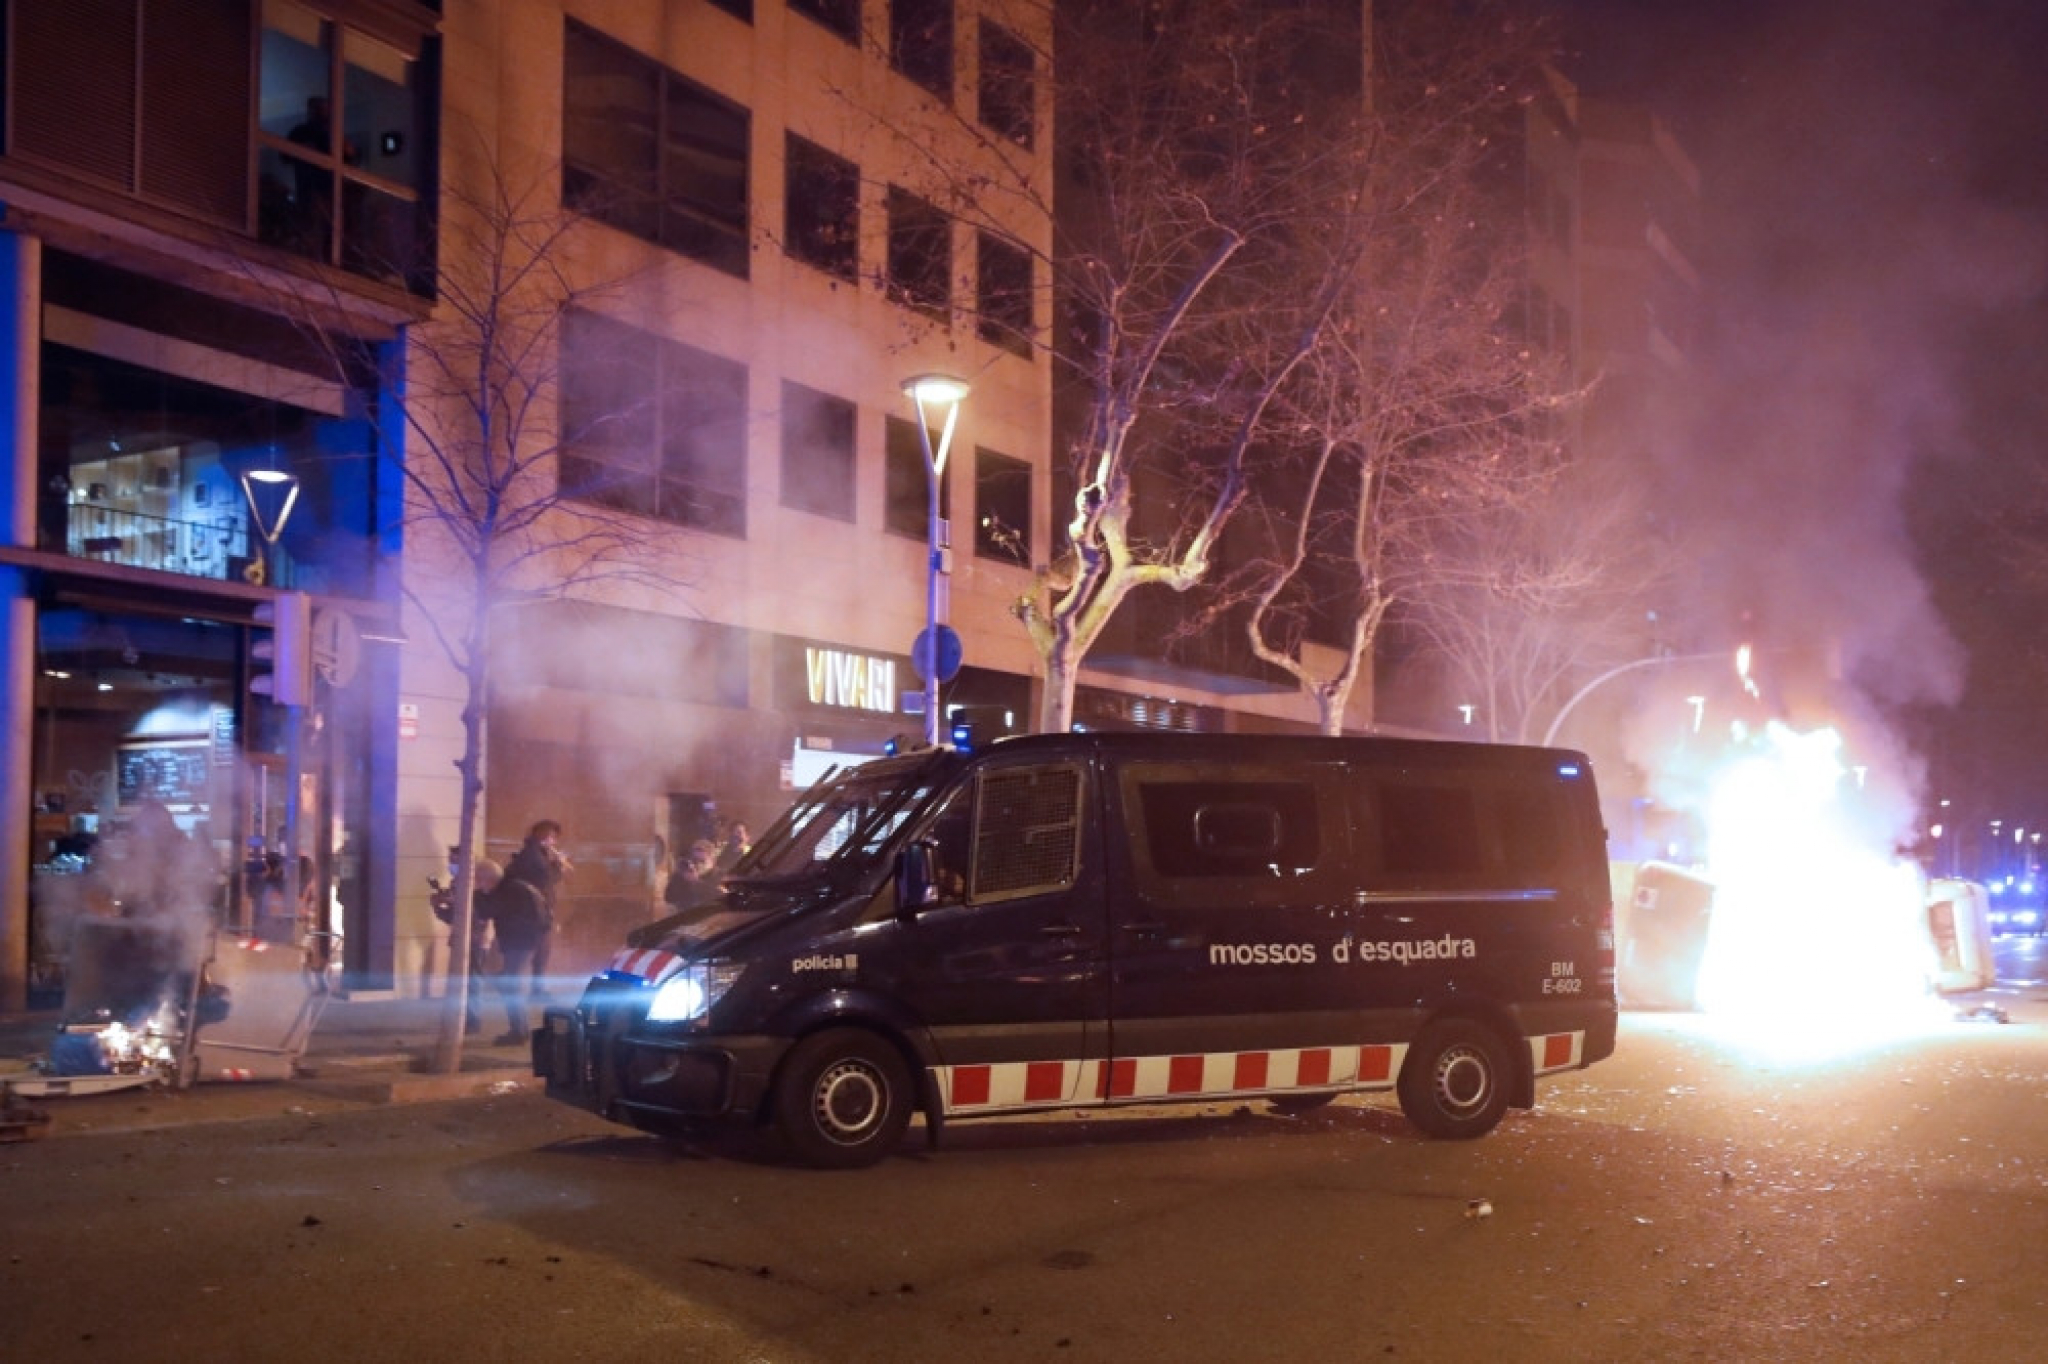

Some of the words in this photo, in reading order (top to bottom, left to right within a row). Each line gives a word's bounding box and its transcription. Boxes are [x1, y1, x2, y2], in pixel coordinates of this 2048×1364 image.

[1209, 943, 1317, 965] mossos
[1360, 933, 1476, 966] esquadra
[792, 953, 843, 974] policia
[1551, 961, 1574, 977] BM
[1541, 978, 1582, 994] E-602
